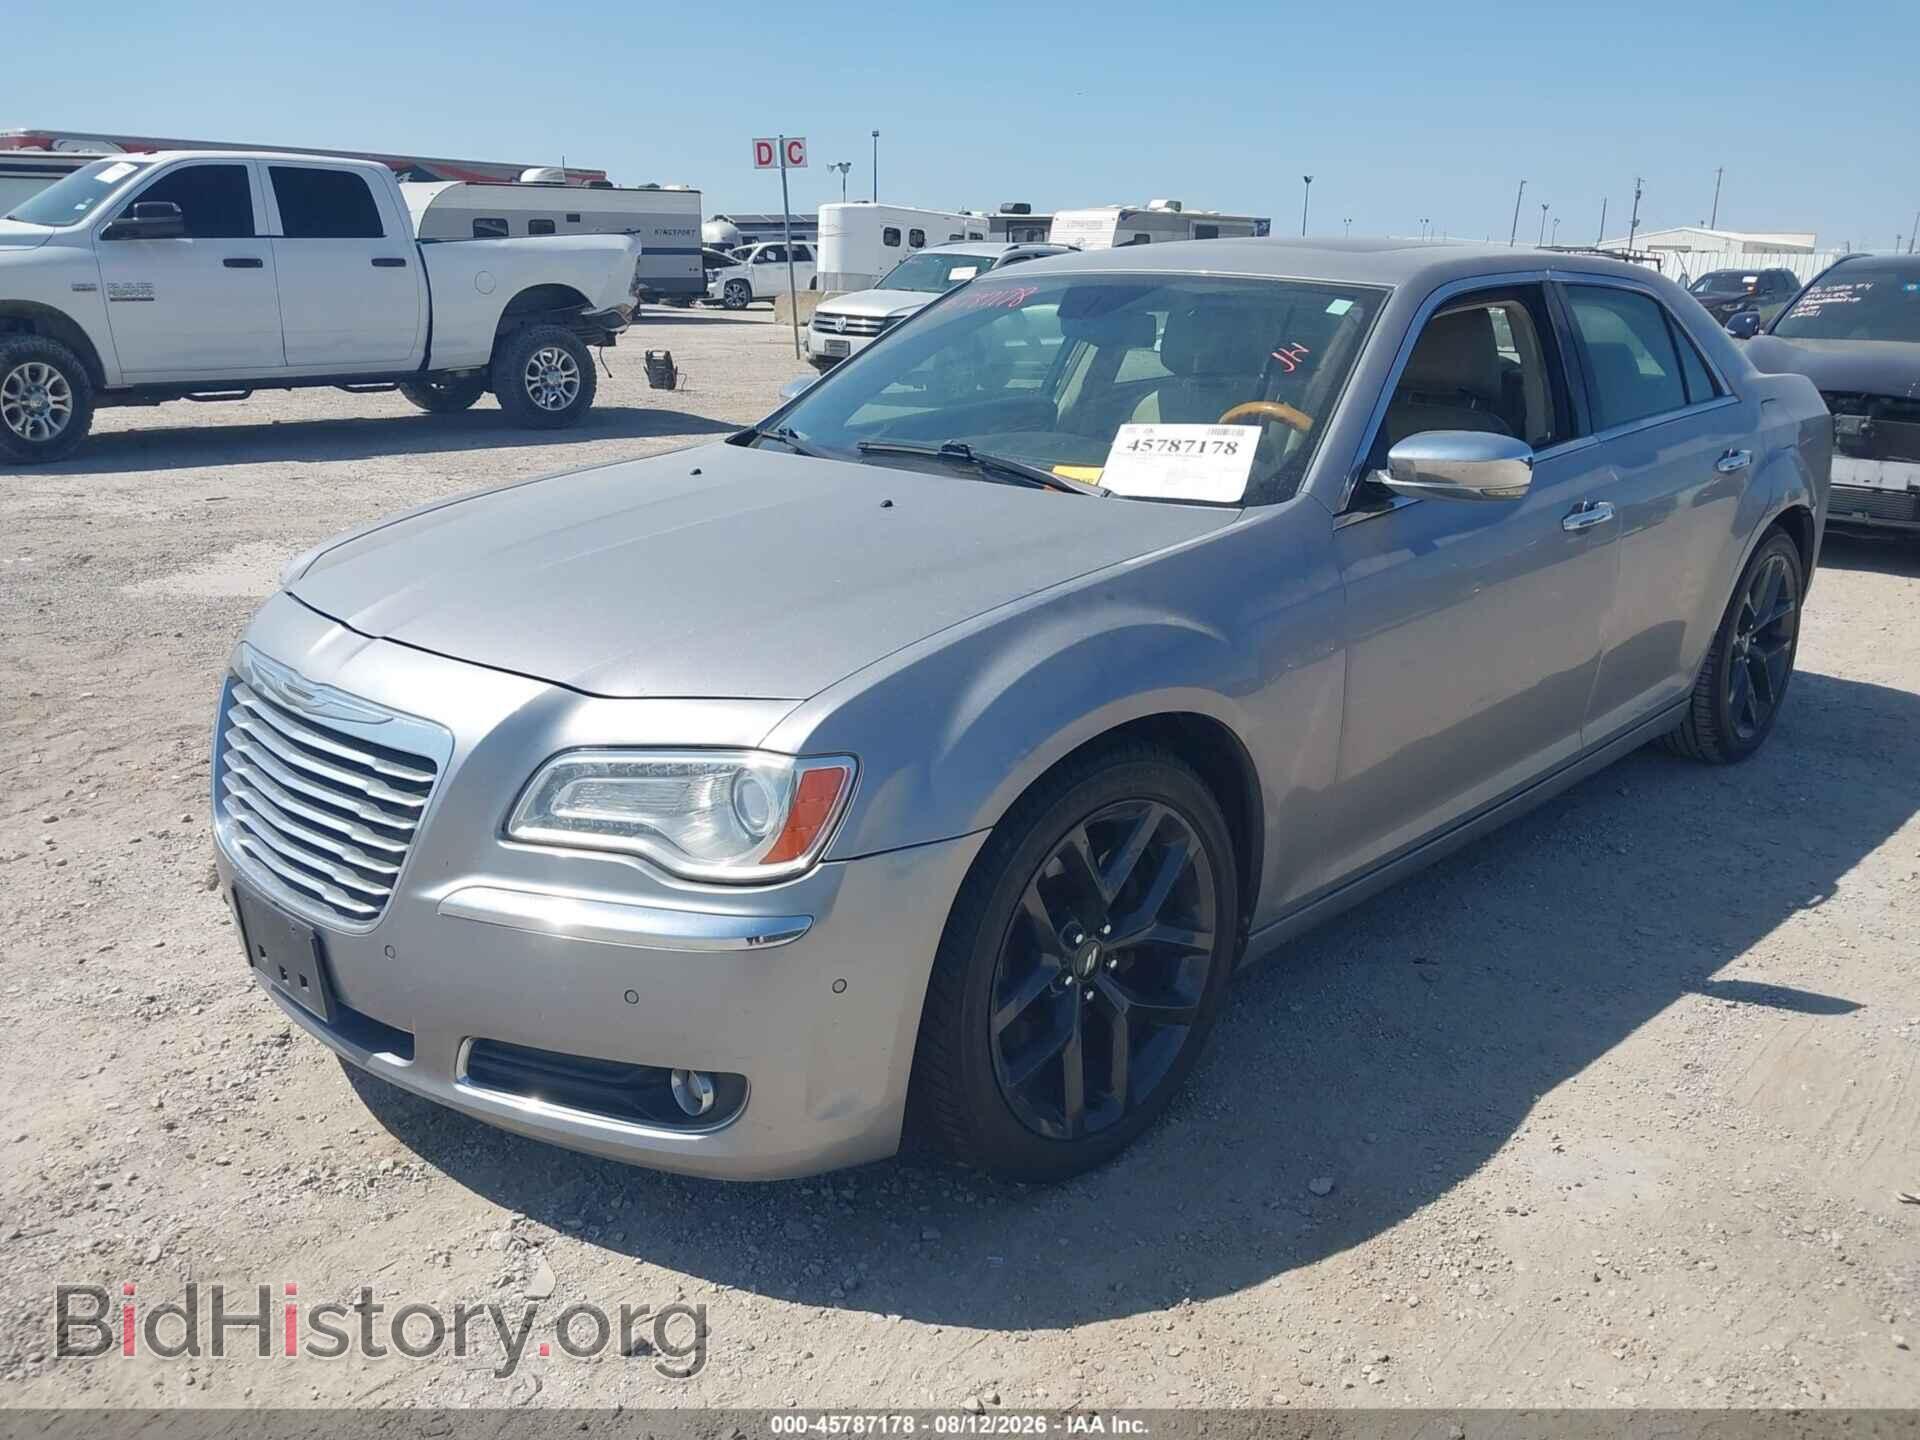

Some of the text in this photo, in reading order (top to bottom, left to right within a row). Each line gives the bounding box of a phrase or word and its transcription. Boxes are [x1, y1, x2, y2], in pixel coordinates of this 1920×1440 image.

[756, 142, 773, 165] D
[788, 141, 803, 164] C
[654, 229, 697, 237] KINGSPORT
[1126, 438, 1239, 456] 45787178
